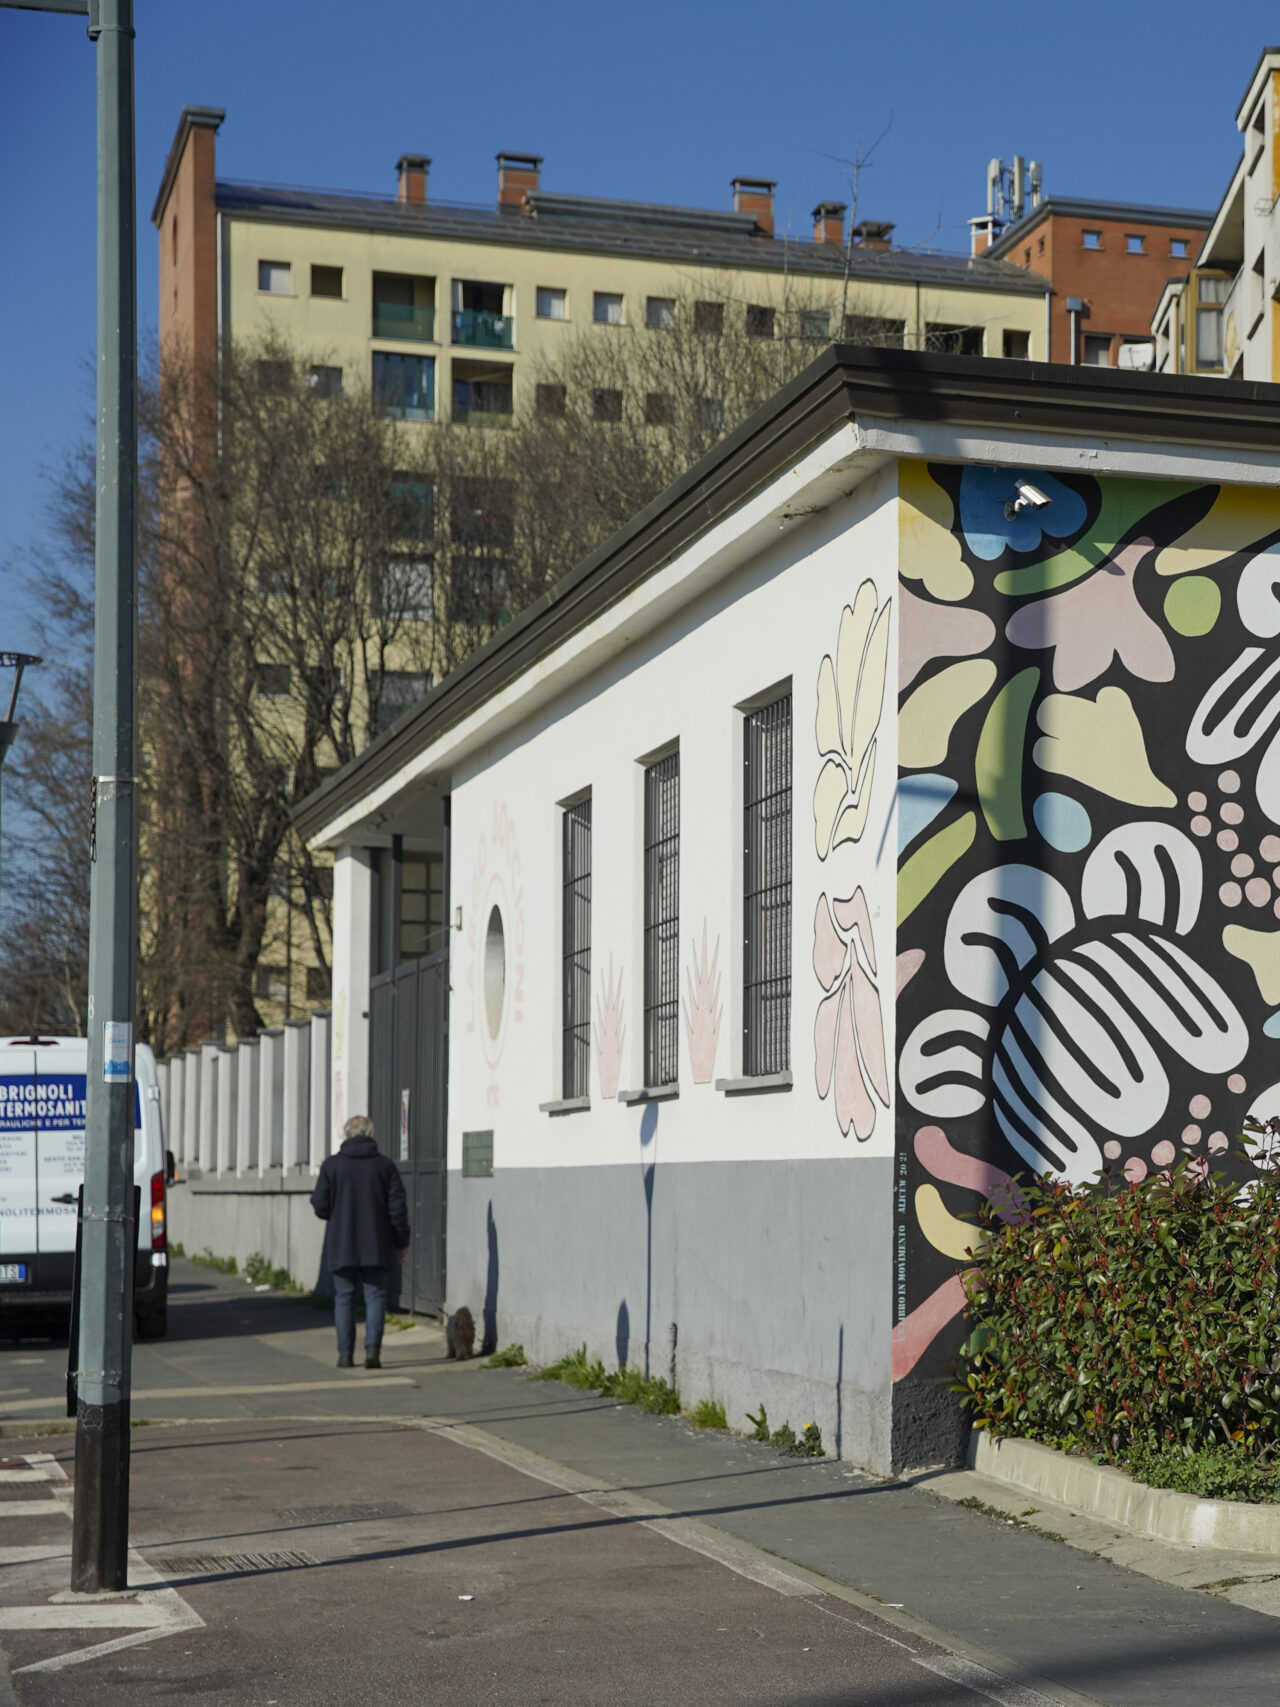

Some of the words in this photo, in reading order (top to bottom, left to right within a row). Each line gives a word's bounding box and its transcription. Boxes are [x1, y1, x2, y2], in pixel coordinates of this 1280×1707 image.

[0, 1084, 73, 1101] BRIGNOLI
[0, 1100, 86, 1117] TERMOSANIT
[898, 1225, 906, 1281] MOVIMENTO
[897, 1284, 906, 1295] IN
